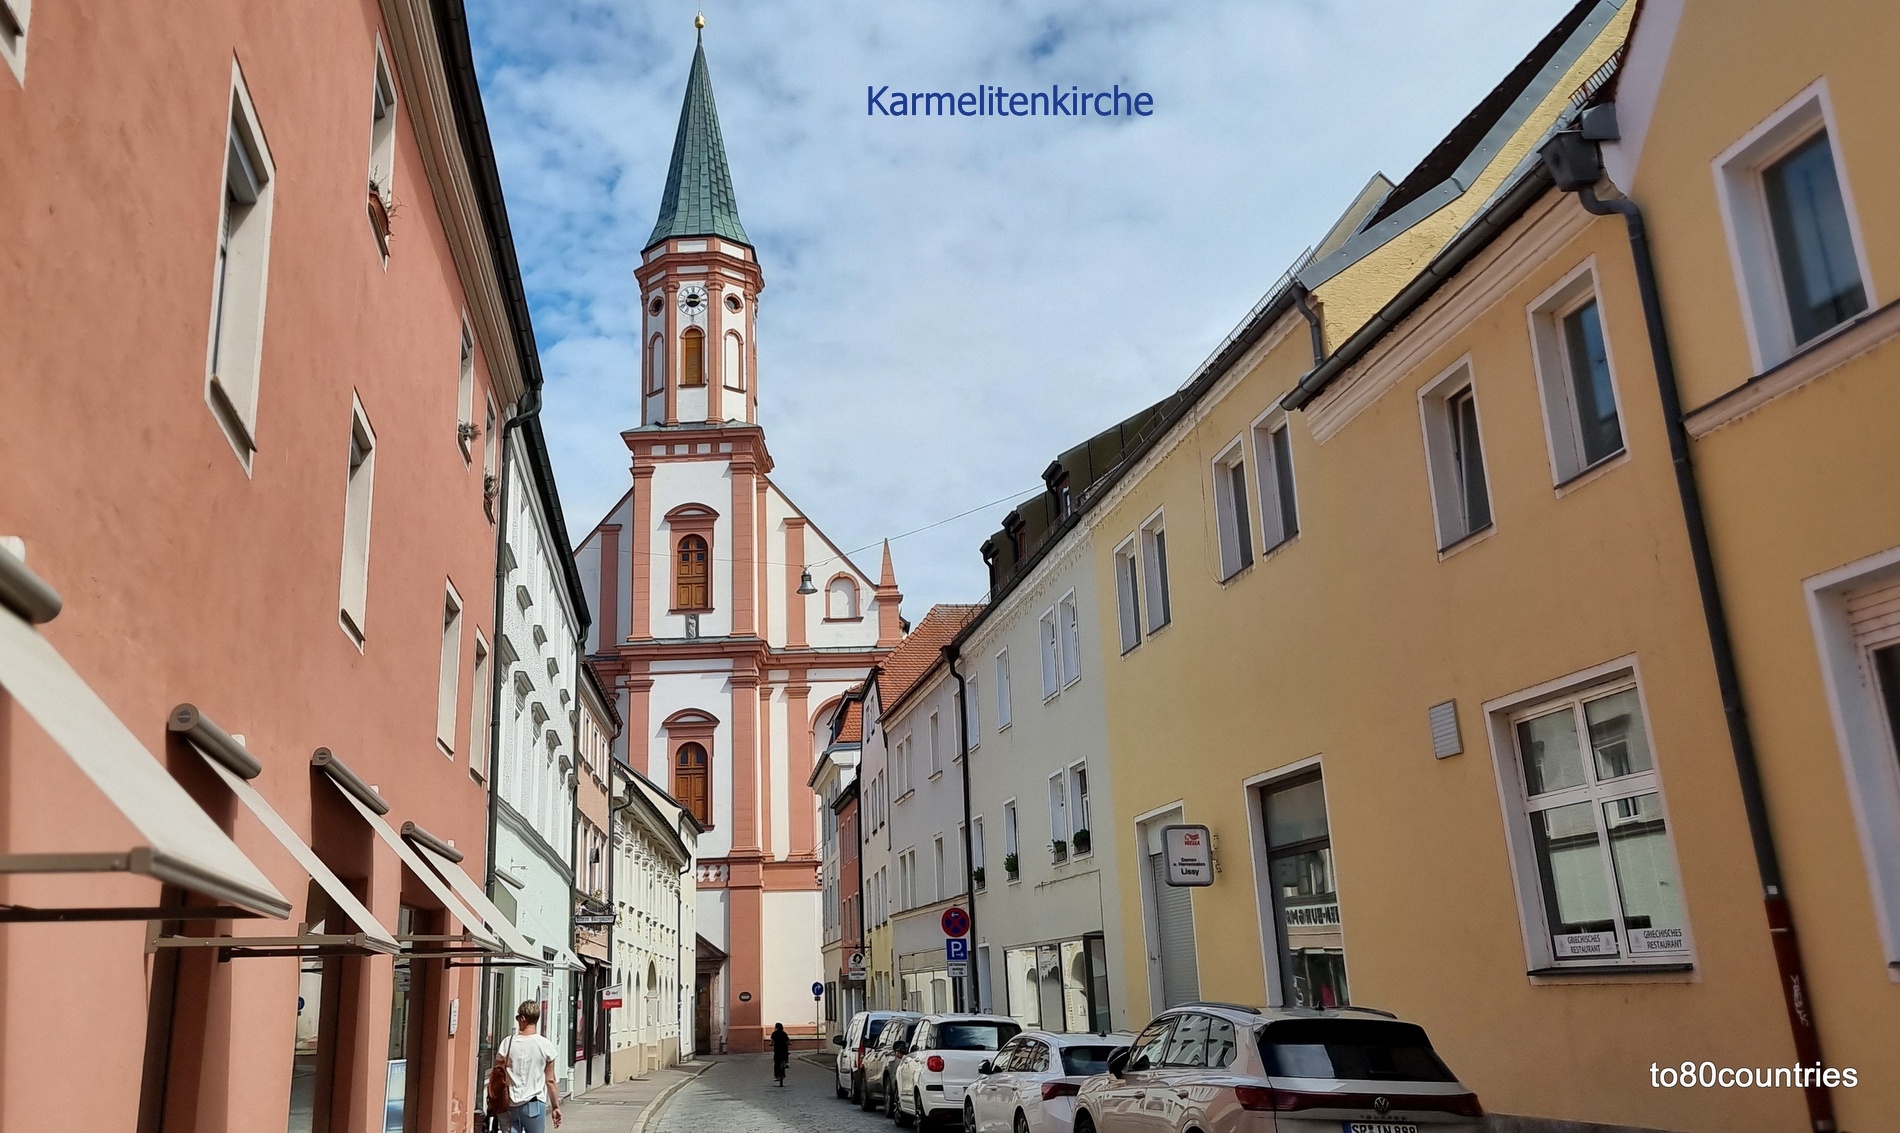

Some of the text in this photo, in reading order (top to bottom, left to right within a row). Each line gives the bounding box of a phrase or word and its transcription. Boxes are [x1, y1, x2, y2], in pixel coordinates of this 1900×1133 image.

[1181, 868, 1200, 876] Lissy
[1643, 928, 1683, 939] GRIECHISCHES
[1567, 934, 1601, 944] GRIECHISCHES
[951, 941, 962, 958] P
[1570, 944, 1601, 954] RESTAURANT
[1647, 939, 1683, 950] RESTAURANT
